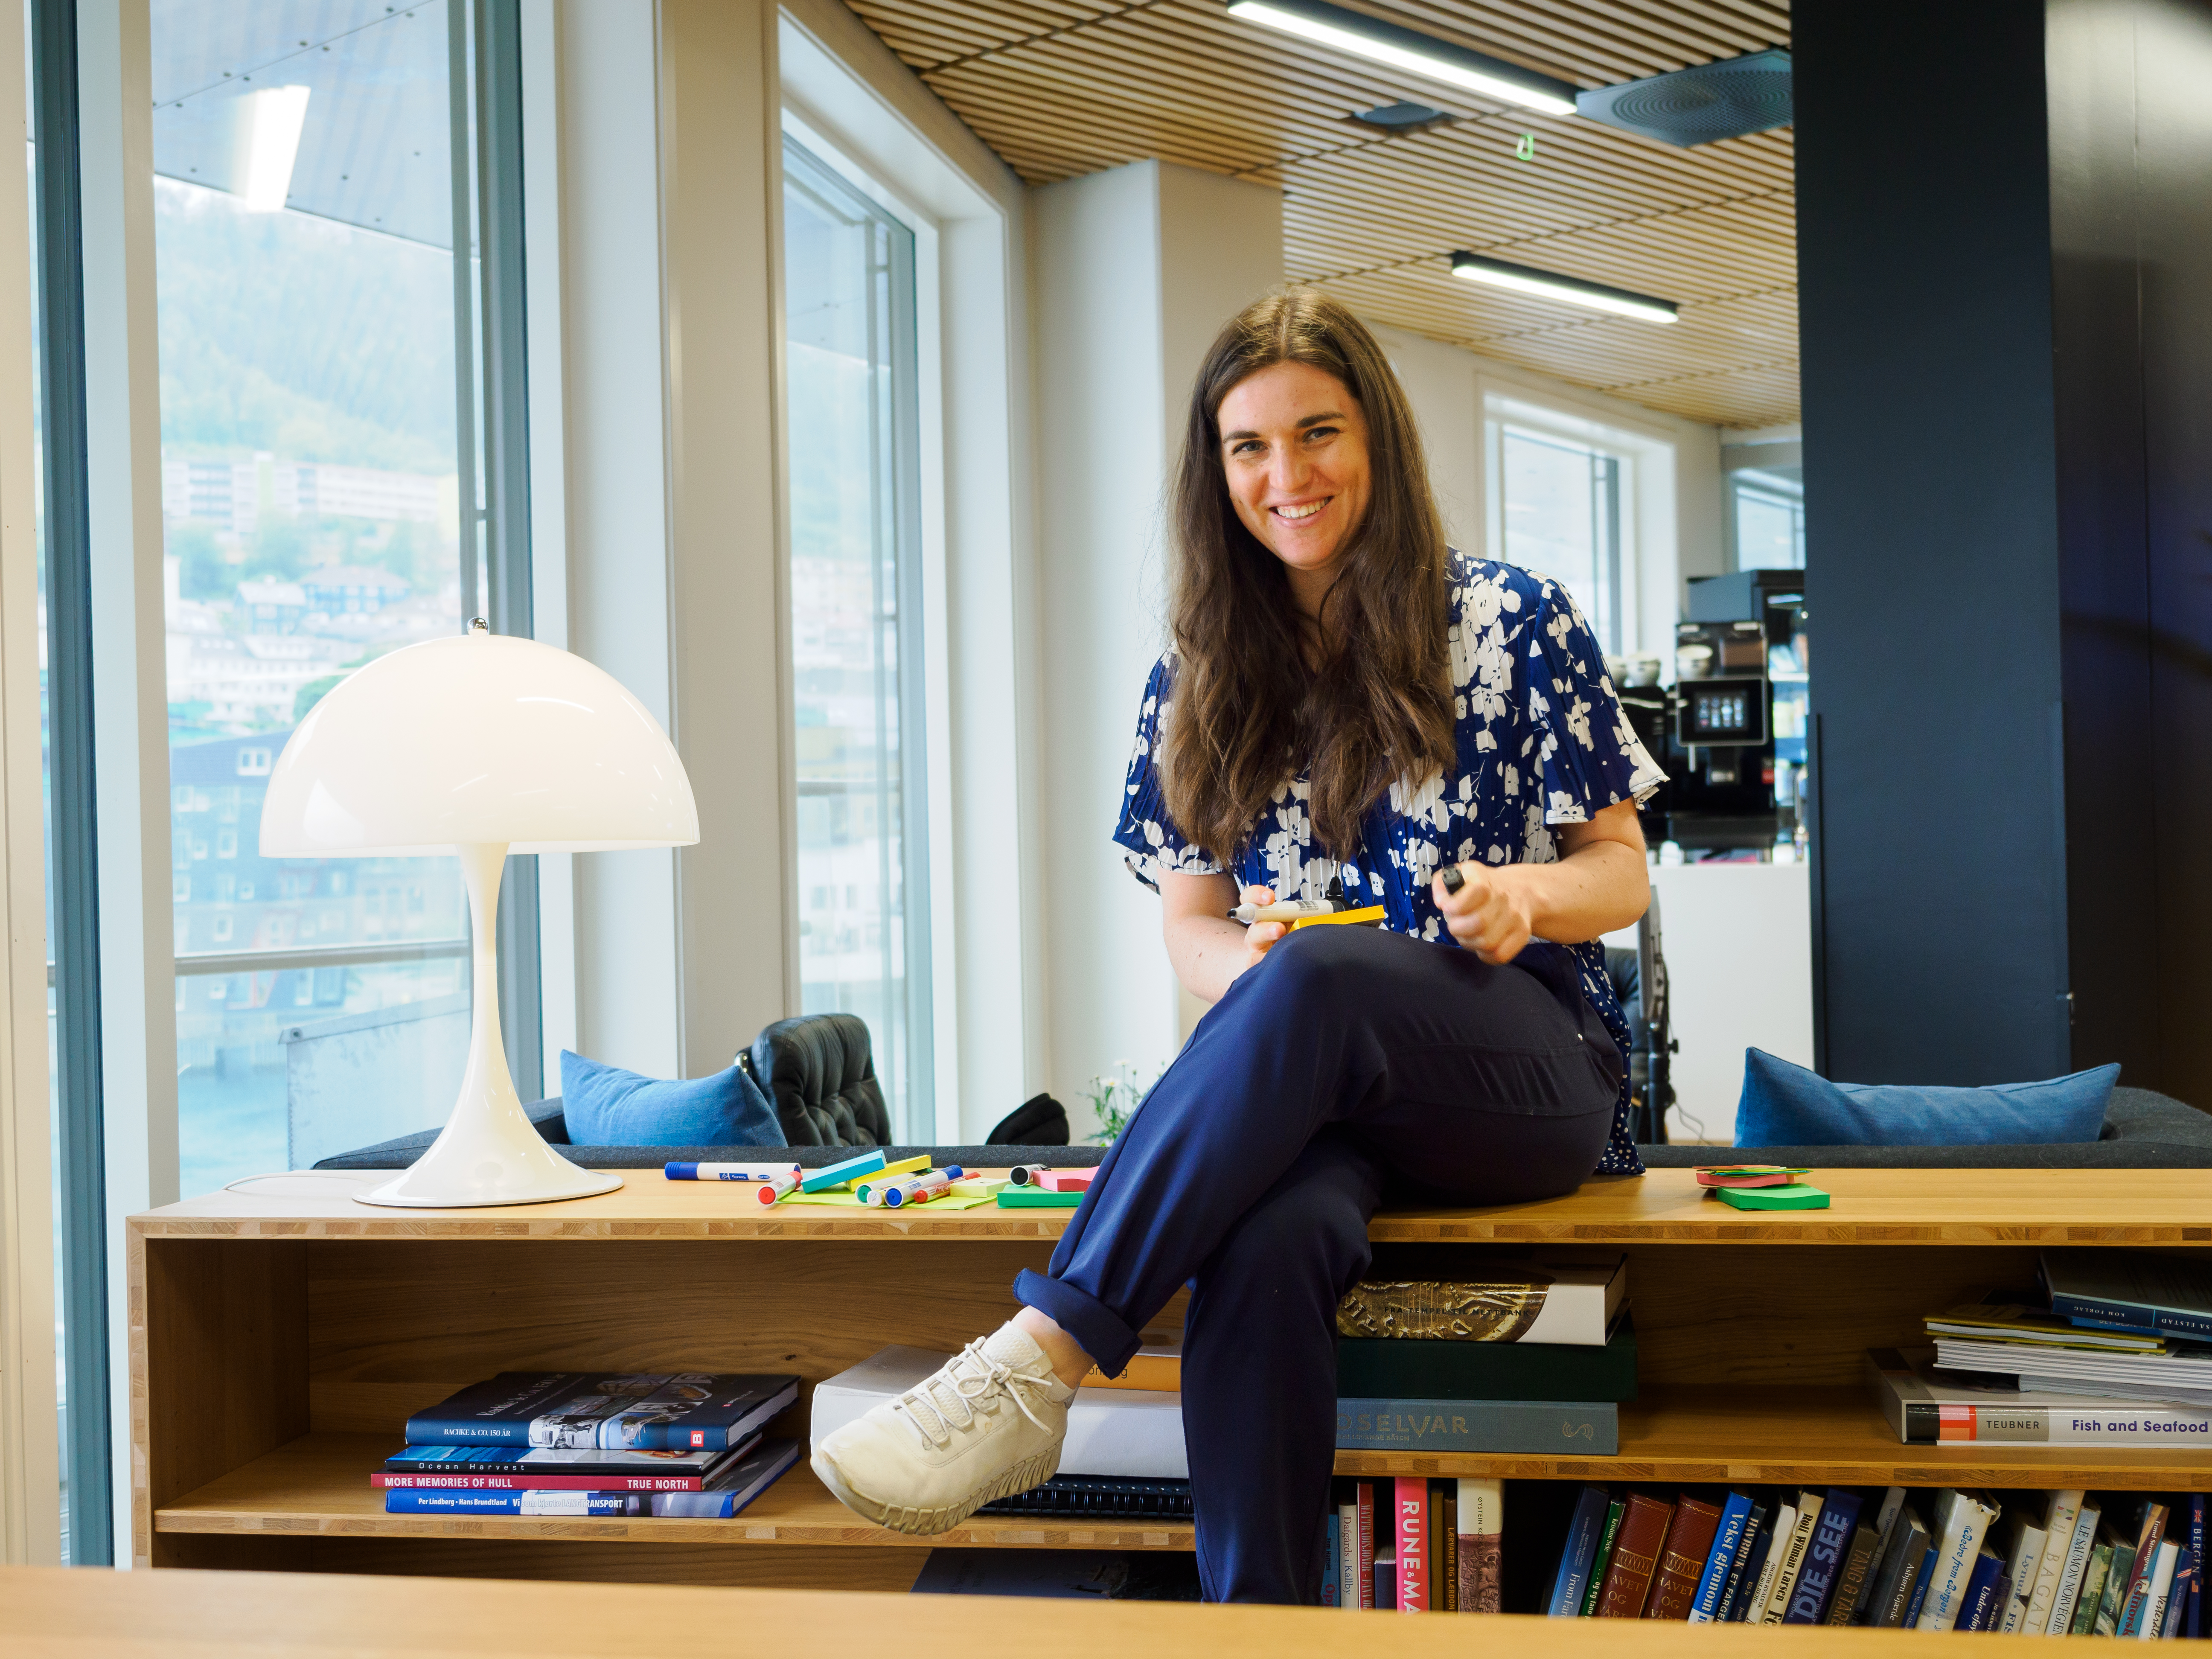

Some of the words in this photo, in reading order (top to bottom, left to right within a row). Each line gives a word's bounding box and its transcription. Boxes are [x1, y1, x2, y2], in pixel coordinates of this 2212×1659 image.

[2074, 1306, 2104, 1315] FORLAG
[2161, 1318, 2195, 1328] ELSTAD
[501, 1428, 511, 1437] ÅR
[1336, 1412, 1469, 1438] OSELVAR
[1986, 1420, 2040, 1430] TEUBNER
[2072, 1419, 2101, 1432] Fish
[2107, 1420, 2138, 1432] and
[2143, 1419, 2209, 1433] Seafood
[419, 1462, 459, 1470] Ocean
[385, 1477, 413, 1487] MORE
[416, 1477, 469, 1487] MEMORIES
[472, 1478, 485, 1487] OF
[488, 1478, 512, 1488] HULL
[627, 1479, 652, 1489] TRUE
[655, 1479, 688, 1490] NORTH
[429, 1498, 455, 1507] Lindberg
[512, 1498, 520, 1507] Vi
[538, 1498, 561, 1510] kjørte
[562, 1499, 623, 1508] LANGTRANSPORT
[1402, 1500, 1420, 1569] RUNE
[1607, 1518, 1618, 1540] Kristine
[1721, 1513, 1745, 1550] Vekst
[1798, 1513, 1814, 1534] Rolf
[2078, 1525, 2091, 1537] LE
[2151, 1520, 2161, 1538] Trond
[1341, 1516, 1353, 1557] Dafgårds
[1361, 1504, 1372, 1572] MATTRADISJONER
[1447, 1527, 1455, 1564] LÆRVARER
[1604, 1540, 1612, 1552] Sele
[1733, 1516, 1759, 1571] HAVBRUK
[1786, 1535, 1807, 1569] Wilman
[2067, 1538, 2087, 1580] SAUMON
[1448, 1566, 1455, 1577] OG
[1763, 1560, 1771, 1576] KURT
[1767, 1562, 1777, 1584] ASGEIR
[1795, 1568, 1828, 1619] DIE
[1813, 1511, 1848, 1565] SEE
[1847, 1549, 1871, 1583] TANG
[1950, 1556, 1964, 1579] frem
[1342, 1565, 1353, 1595] Källby
[1565, 1573, 1580, 1599] From
[1592, 1581, 1600, 1589] og
[1610, 1574, 1642, 1592] AVET
[1701, 1551, 1728, 1611] gjennom
[1729, 1572, 1739, 1586] ET
[1775, 1570, 1794, 1602] Larsen
[1898, 1563, 1915, 1592] Asbjørn
[2013, 1553, 2034, 1600] Lynum
[1362, 1579, 1372, 1598] FANA
[1589, 1591, 1598, 1599] eg
[1608, 1590, 1627, 1604] OG
[1752, 1576, 1765, 1604] SOLBERG
[1757, 1583, 1770, 1609] KVALVIK
[1788, 1594, 1801, 1618] THOMAS
[1797, 1579, 1806, 1594] RUHL
[1814, 1575, 1831, 1615] CULINARIUM
[1827, 1565, 1835, 1577] DER
[1939, 1579, 1957, 1613] Bergen
[1976, 1586, 1991, 1613] Under
[1587, 1600, 1596, 1615] fann
[1661, 1596, 1680, 1610] OG
[1736, 1606, 1745, 1621] Jacob
[1889, 1594, 1905, 1621] Gjærde
[1994, 1603, 1999, 1611] JO
[2052, 1580, 2076, 1636] NORVÉGIEN
